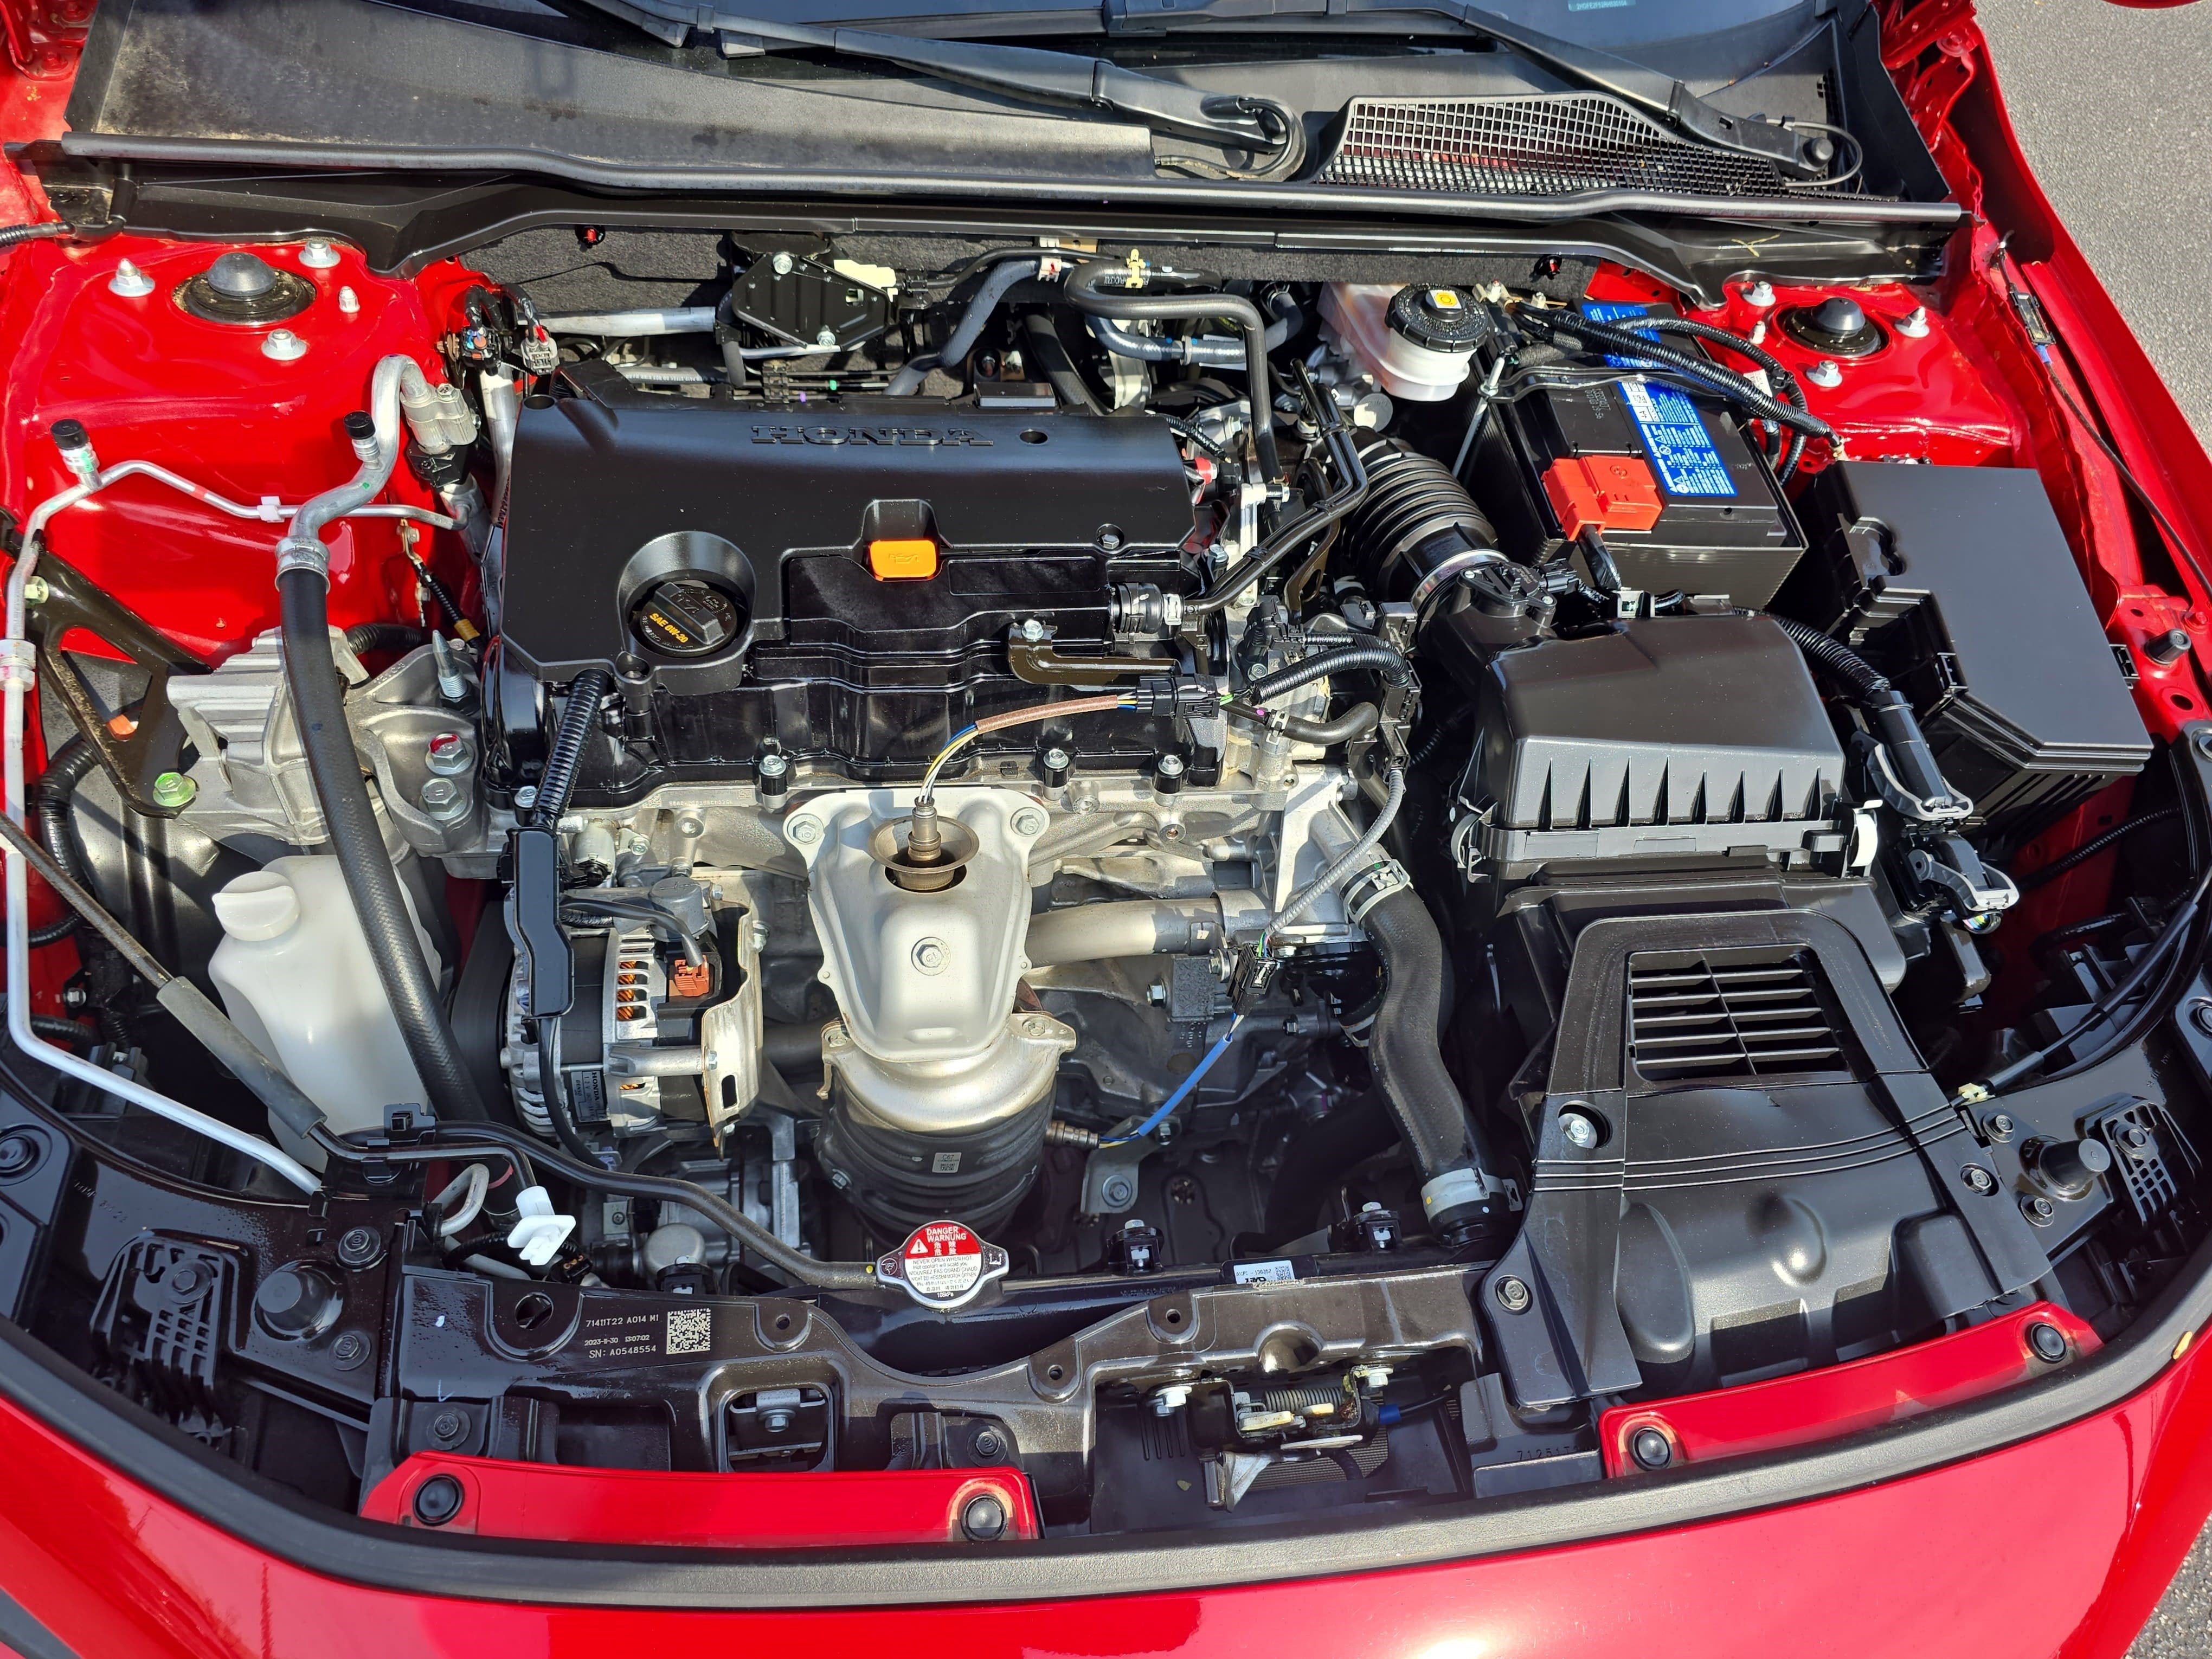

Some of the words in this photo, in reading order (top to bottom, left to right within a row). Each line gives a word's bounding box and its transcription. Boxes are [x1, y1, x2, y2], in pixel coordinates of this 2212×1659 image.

[751, 425, 994, 446] HONDA
[649, 613, 669, 627] SAE
[664, 624, 689, 644] 0W-20
[591, 1072, 600, 1101] HONDA
[926, 1226, 959, 1236] DANGER
[928, 1232, 967, 1243] WARNUNG
[586, 1317, 623, 1328] 71411T22
[626, 1314, 647, 1324] A014
[584, 1336, 619, 1346] 2023-11-30
[589, 1348, 606, 1359] SN:
[609, 1345, 657, 1356] A0548554
